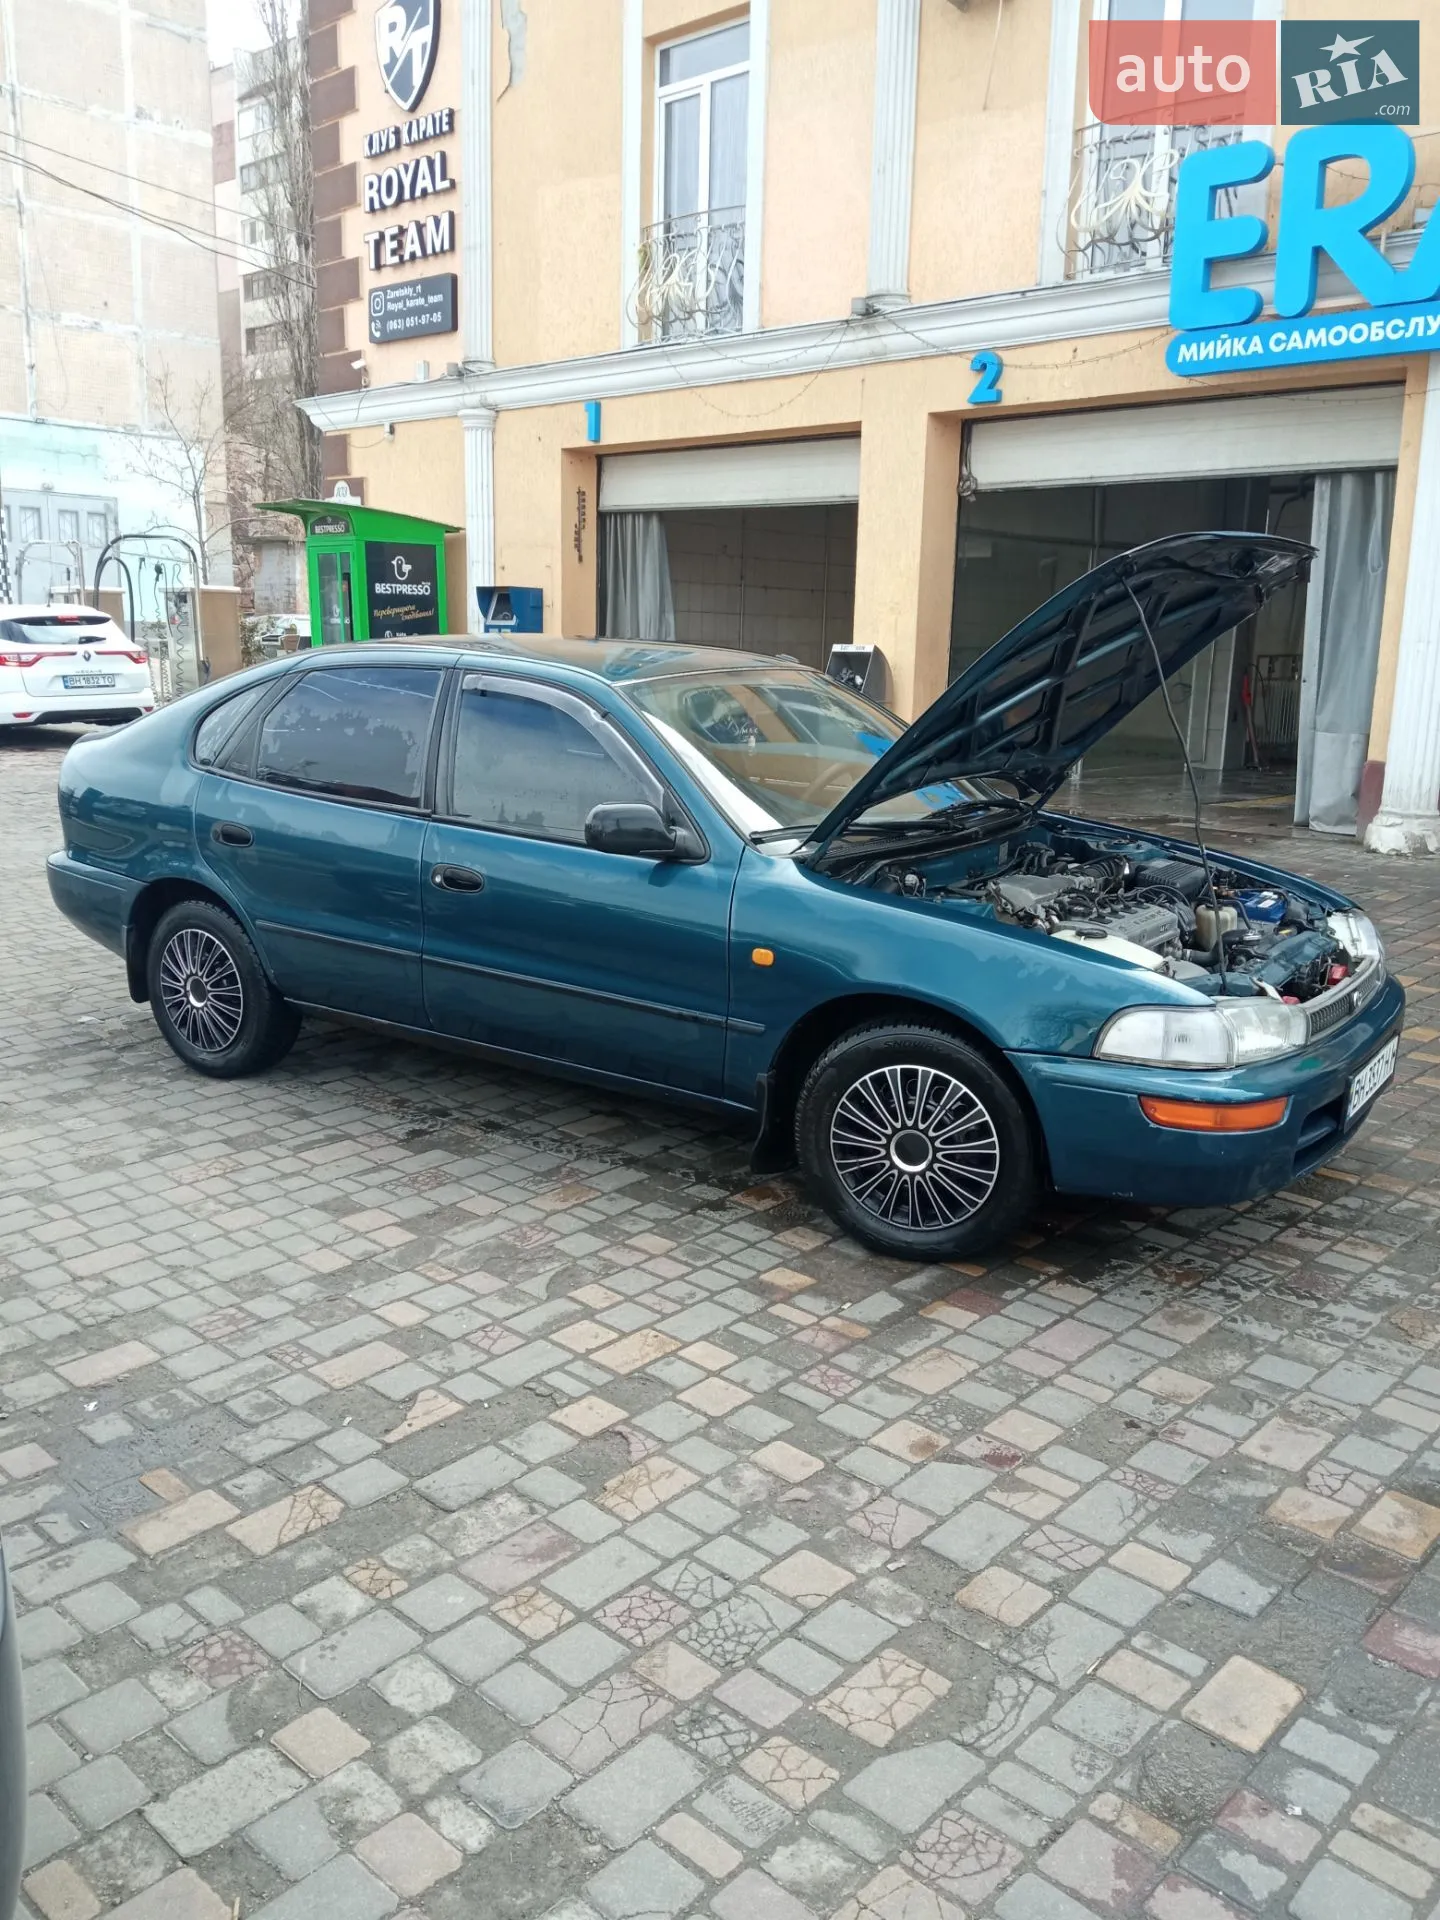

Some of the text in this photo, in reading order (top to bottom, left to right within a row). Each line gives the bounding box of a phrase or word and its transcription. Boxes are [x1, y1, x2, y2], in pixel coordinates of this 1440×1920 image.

[364, 107, 451, 158] КЛУБ КАРАТЕ
[364, 150, 451, 213] ROYAL
[364, 211, 451, 270] TEAM
[386, 311, 442, 333] (063) 051-97-05
[1177, 333, 1264, 364] МИЙКА
[967, 350, 1004, 405] 2
[584, 399, 601, 443] 1
[375, 583, 431, 595] BESTPRESSO
